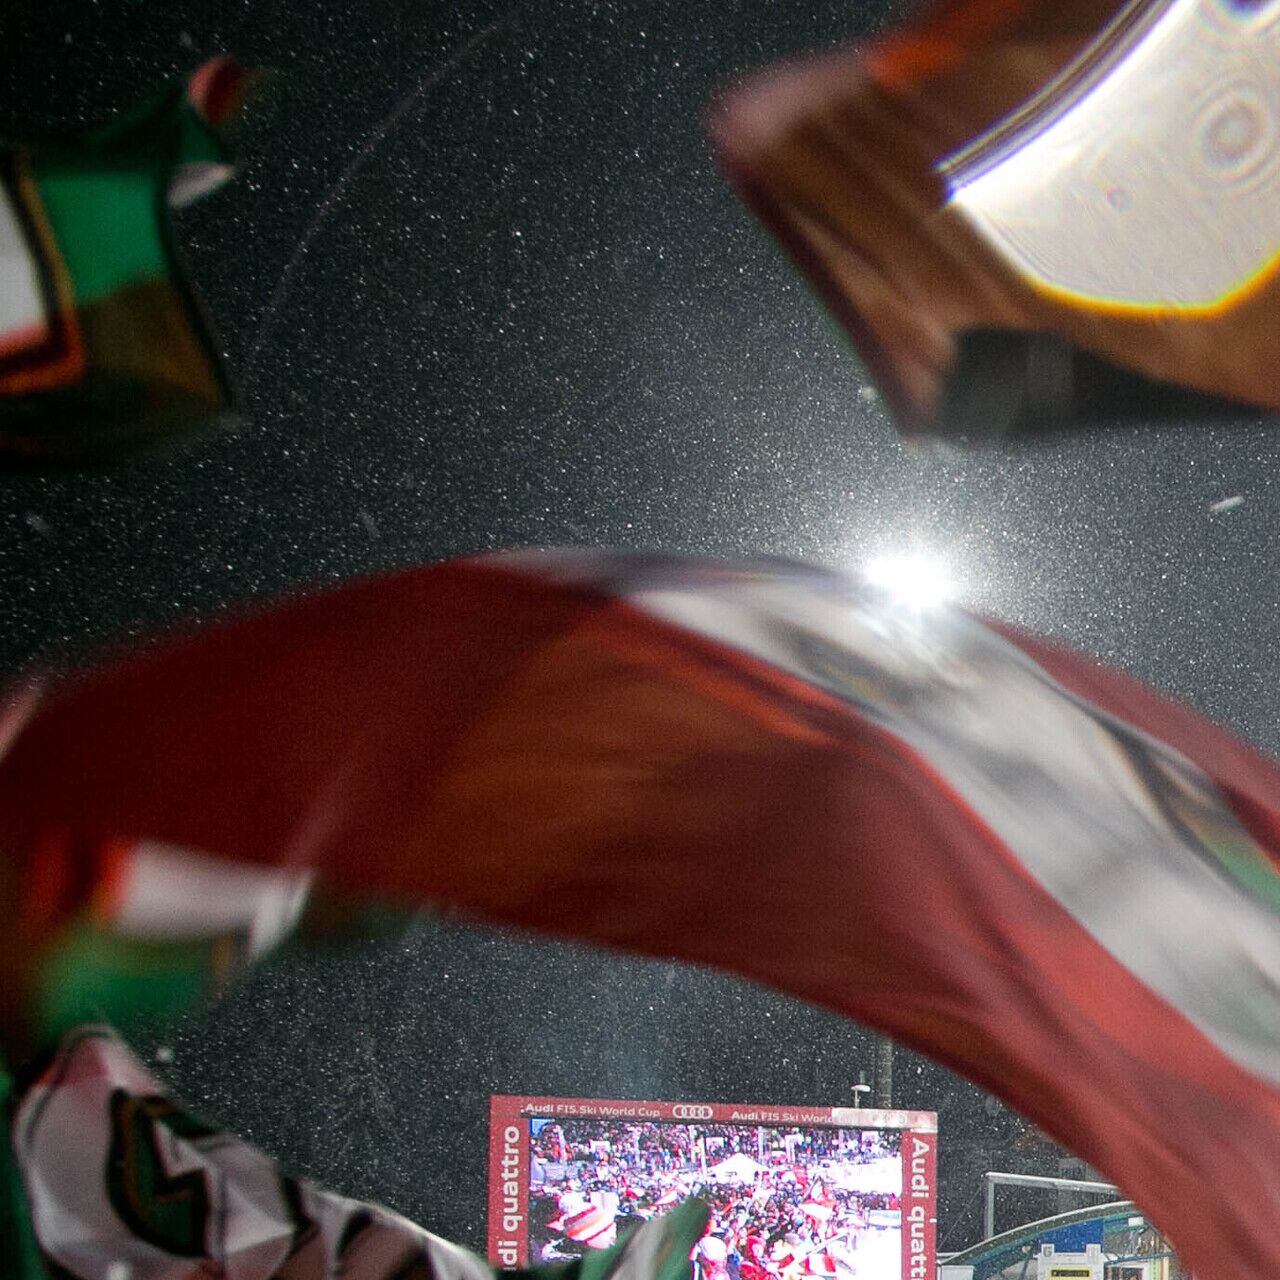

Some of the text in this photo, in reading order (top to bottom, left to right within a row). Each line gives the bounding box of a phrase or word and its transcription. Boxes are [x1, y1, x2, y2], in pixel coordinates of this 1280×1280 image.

[526, 1103, 661, 1119] Audi FIS Ski World Cup
[731, 1110, 758, 1121] Audi
[761, 1112, 779, 1121] FIS
[782, 1112, 799, 1122] Ski
[500, 1125, 521, 1233] quattro
[912, 1137, 929, 1199] Audi
